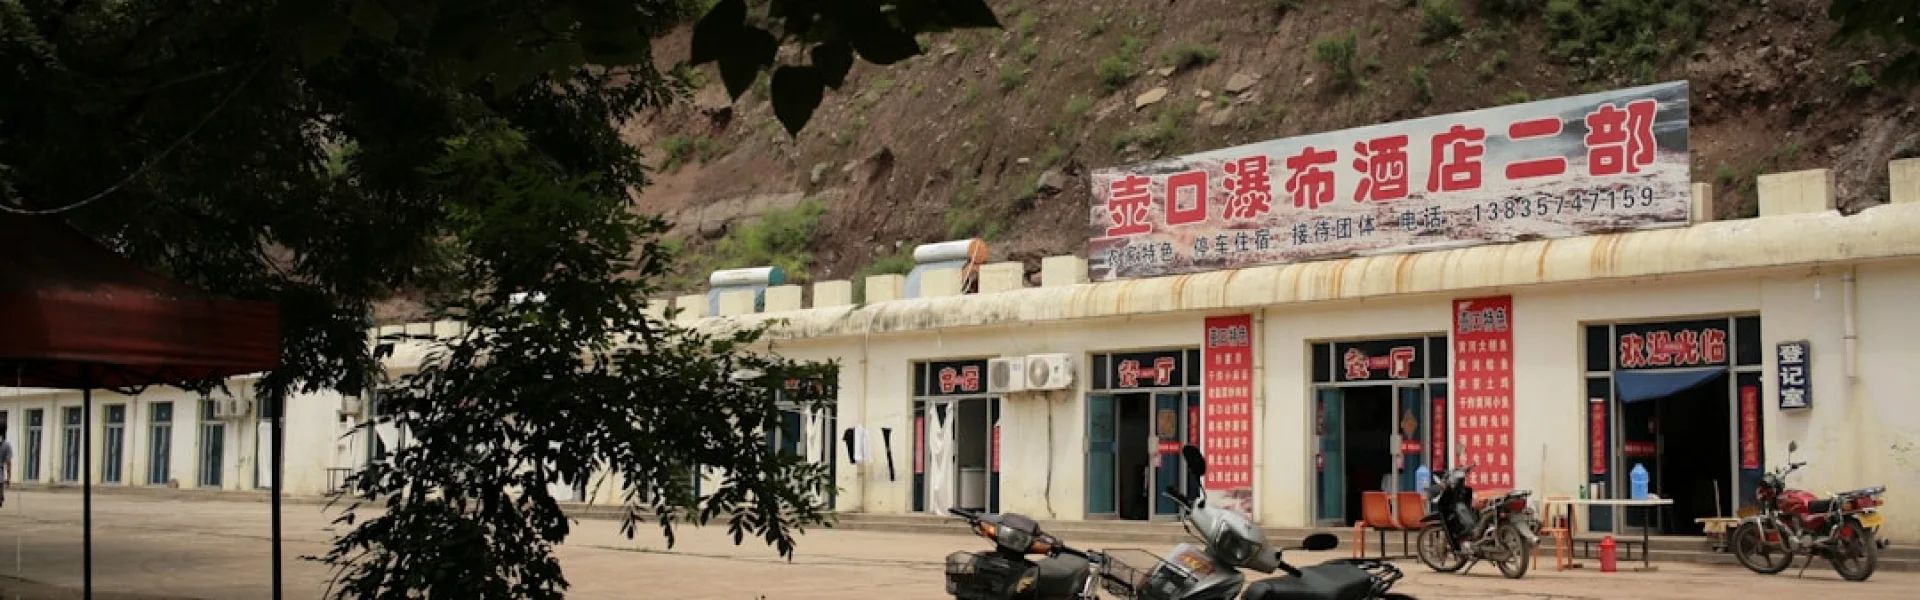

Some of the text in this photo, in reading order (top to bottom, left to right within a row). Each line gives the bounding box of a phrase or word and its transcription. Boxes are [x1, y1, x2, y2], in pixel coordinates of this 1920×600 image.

[1106, 99, 1657, 238] 壶口瀑布酒店二部
[1194, 228, 1270, 258] 停车住宿
[1292, 215, 1375, 245] 接待团体
[1400, 205, 1442, 230] 电话
[1473, 187, 1654, 221] 13835747159
[1458, 306, 1507, 333] 壶口特色
[1344, 346, 1416, 380] 餐厅
[1620, 328, 1727, 369] 欢迎光临
[1118, 357, 1176, 388] 餐厅
[1778, 343, 1806, 408] 登记室
